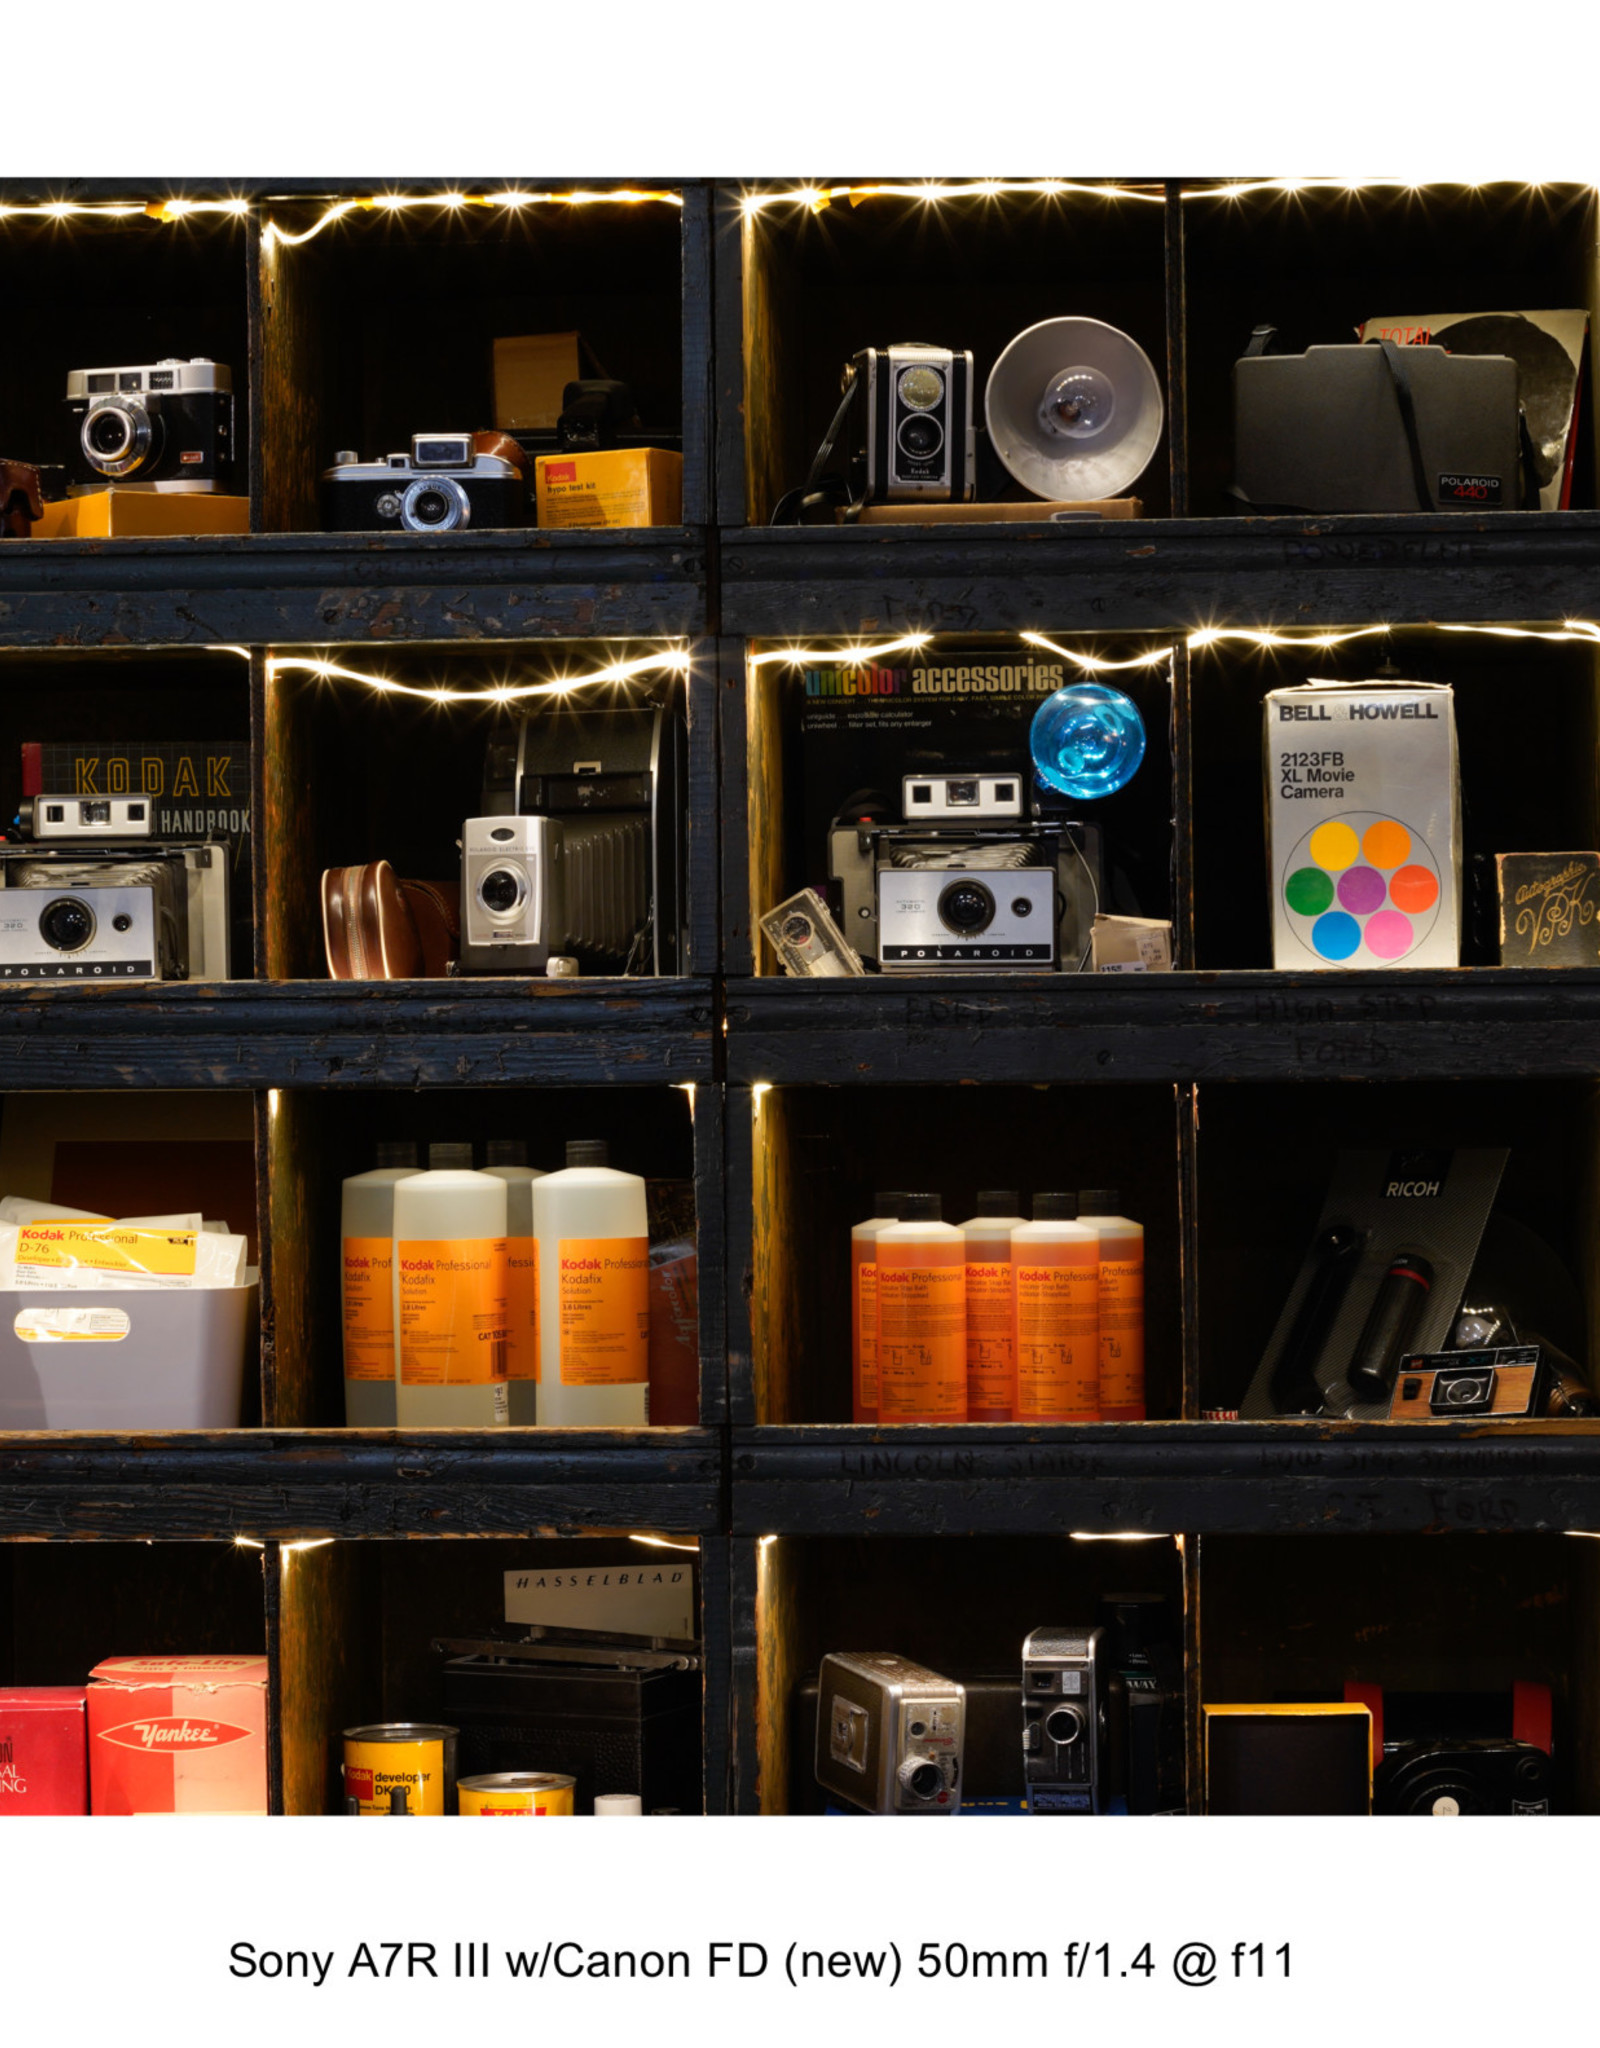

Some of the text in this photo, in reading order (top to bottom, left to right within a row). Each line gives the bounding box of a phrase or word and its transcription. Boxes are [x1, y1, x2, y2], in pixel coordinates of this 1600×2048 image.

[1441, 476, 1499, 488] POLAROID
[1453, 486, 1487, 499] 440
[806, 658, 1064, 696] unicolor accessories
[1279, 705, 1331, 721] BELL
[1349, 703, 1438, 720] HOWELL
[1281, 752, 1344, 767] 2123FB
[76, 757, 231, 796] KODAK
[1281, 768, 1355, 783] XL Movie
[1281, 784, 1344, 799] Camera
[161, 809, 251, 833] HANDBOOK
[901, 949, 1033, 957] POLAROID
[4, 966, 135, 976] POLAROID
[1385, 1180, 1440, 1198] RICOH
[21, 1229, 65, 1241] Kodak
[19, 1242, 50, 1254] D-76
[401, 1259, 492, 1272] Kodak Professional
[561, 1258, 602, 1270] Kodak
[561, 1273, 602, 1285] Kodafix
[881, 1272, 909, 1283] Kodak
[966, 1267, 999, 1278] Kodak
[1019, 1270, 1051, 1281] Kodak
[402, 1275, 435, 1285] Kodafix
[840, 1450, 975, 1477] LINCOLN
[516, 1572, 683, 1589] HASSELBLAD
[133, 1720, 218, 1748] Yankee
[374, 1772, 430, 1784] developer
